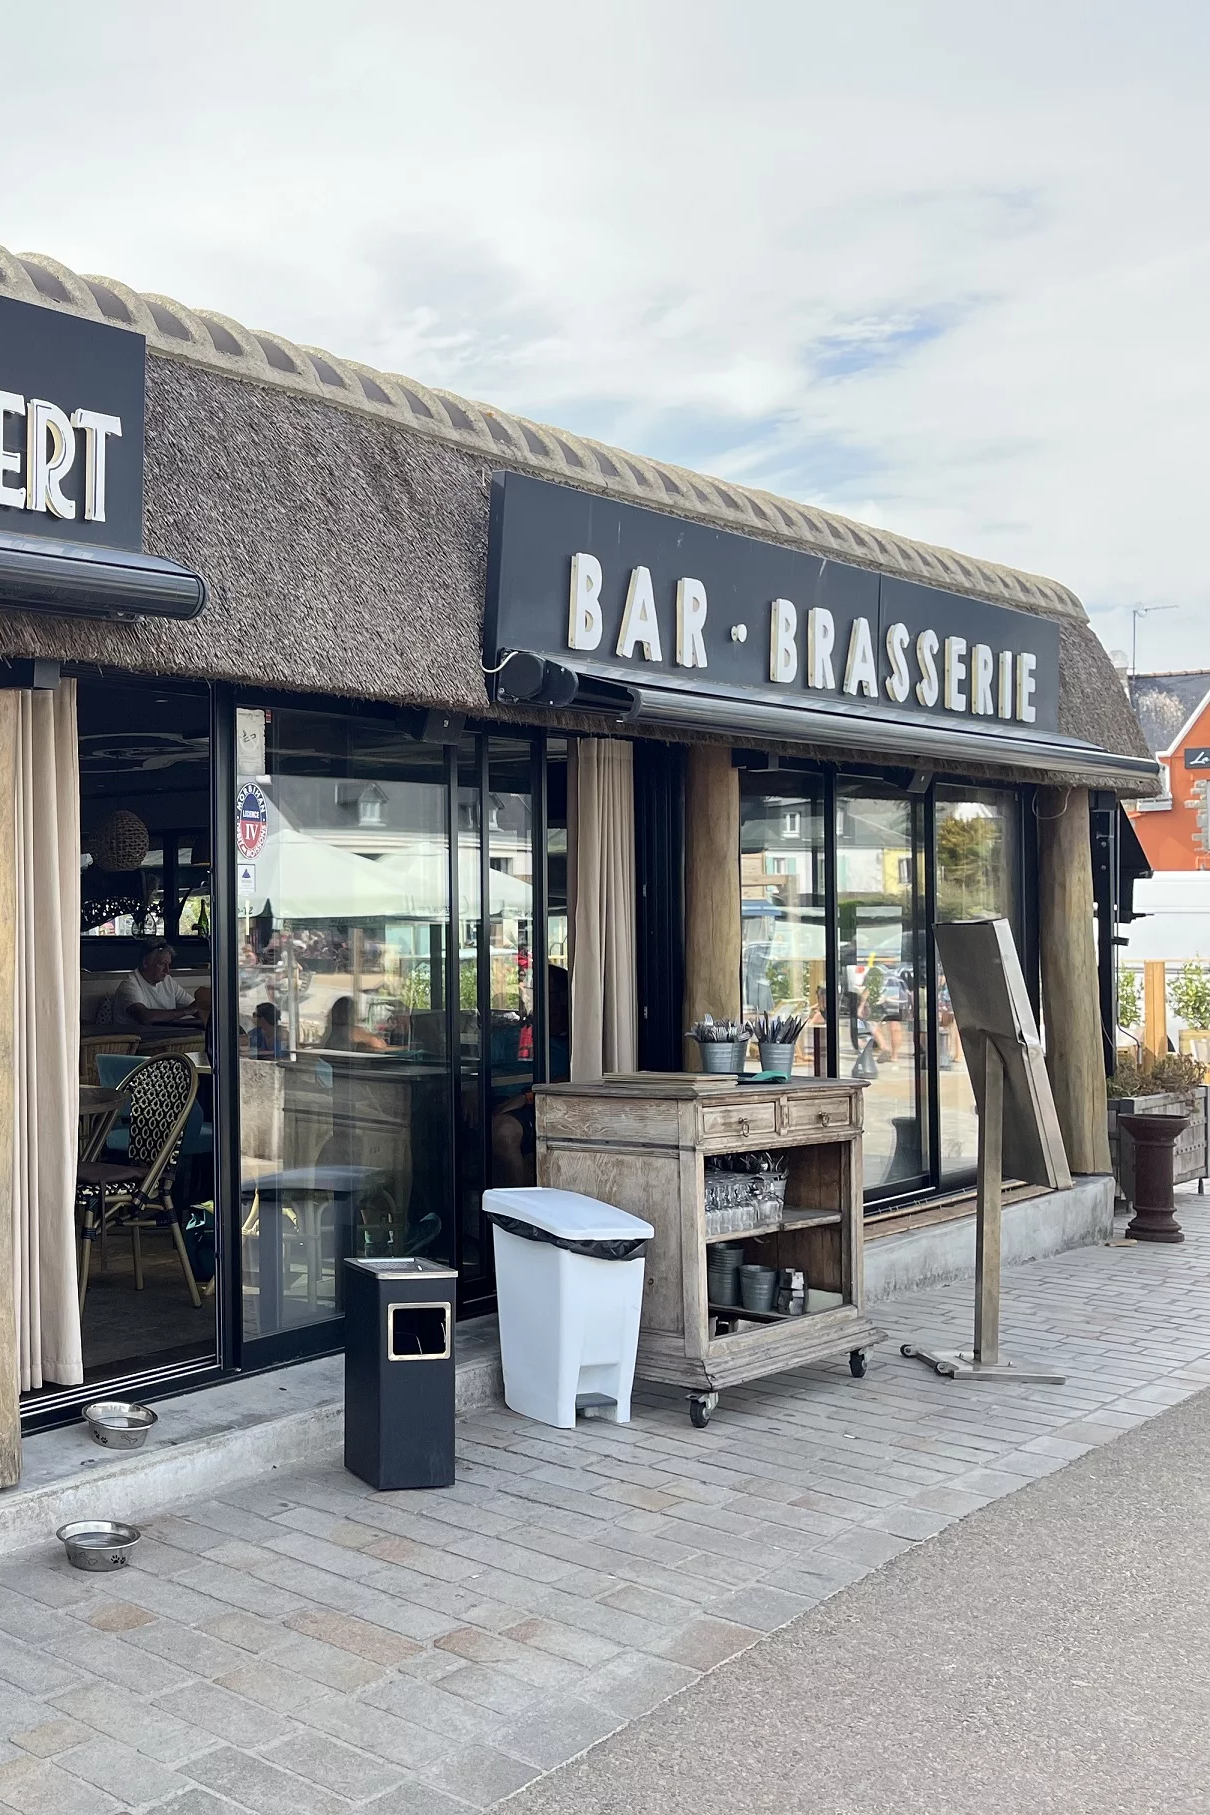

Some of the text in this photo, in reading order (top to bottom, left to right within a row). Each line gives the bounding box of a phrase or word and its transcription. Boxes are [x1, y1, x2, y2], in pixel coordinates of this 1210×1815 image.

[567, 551, 1037, 723] BAR BRASSERIE
[237, 784, 266, 813] MORBIHAN
[242, 809, 260, 819] LICENCE
[245, 823, 258, 841] IV
